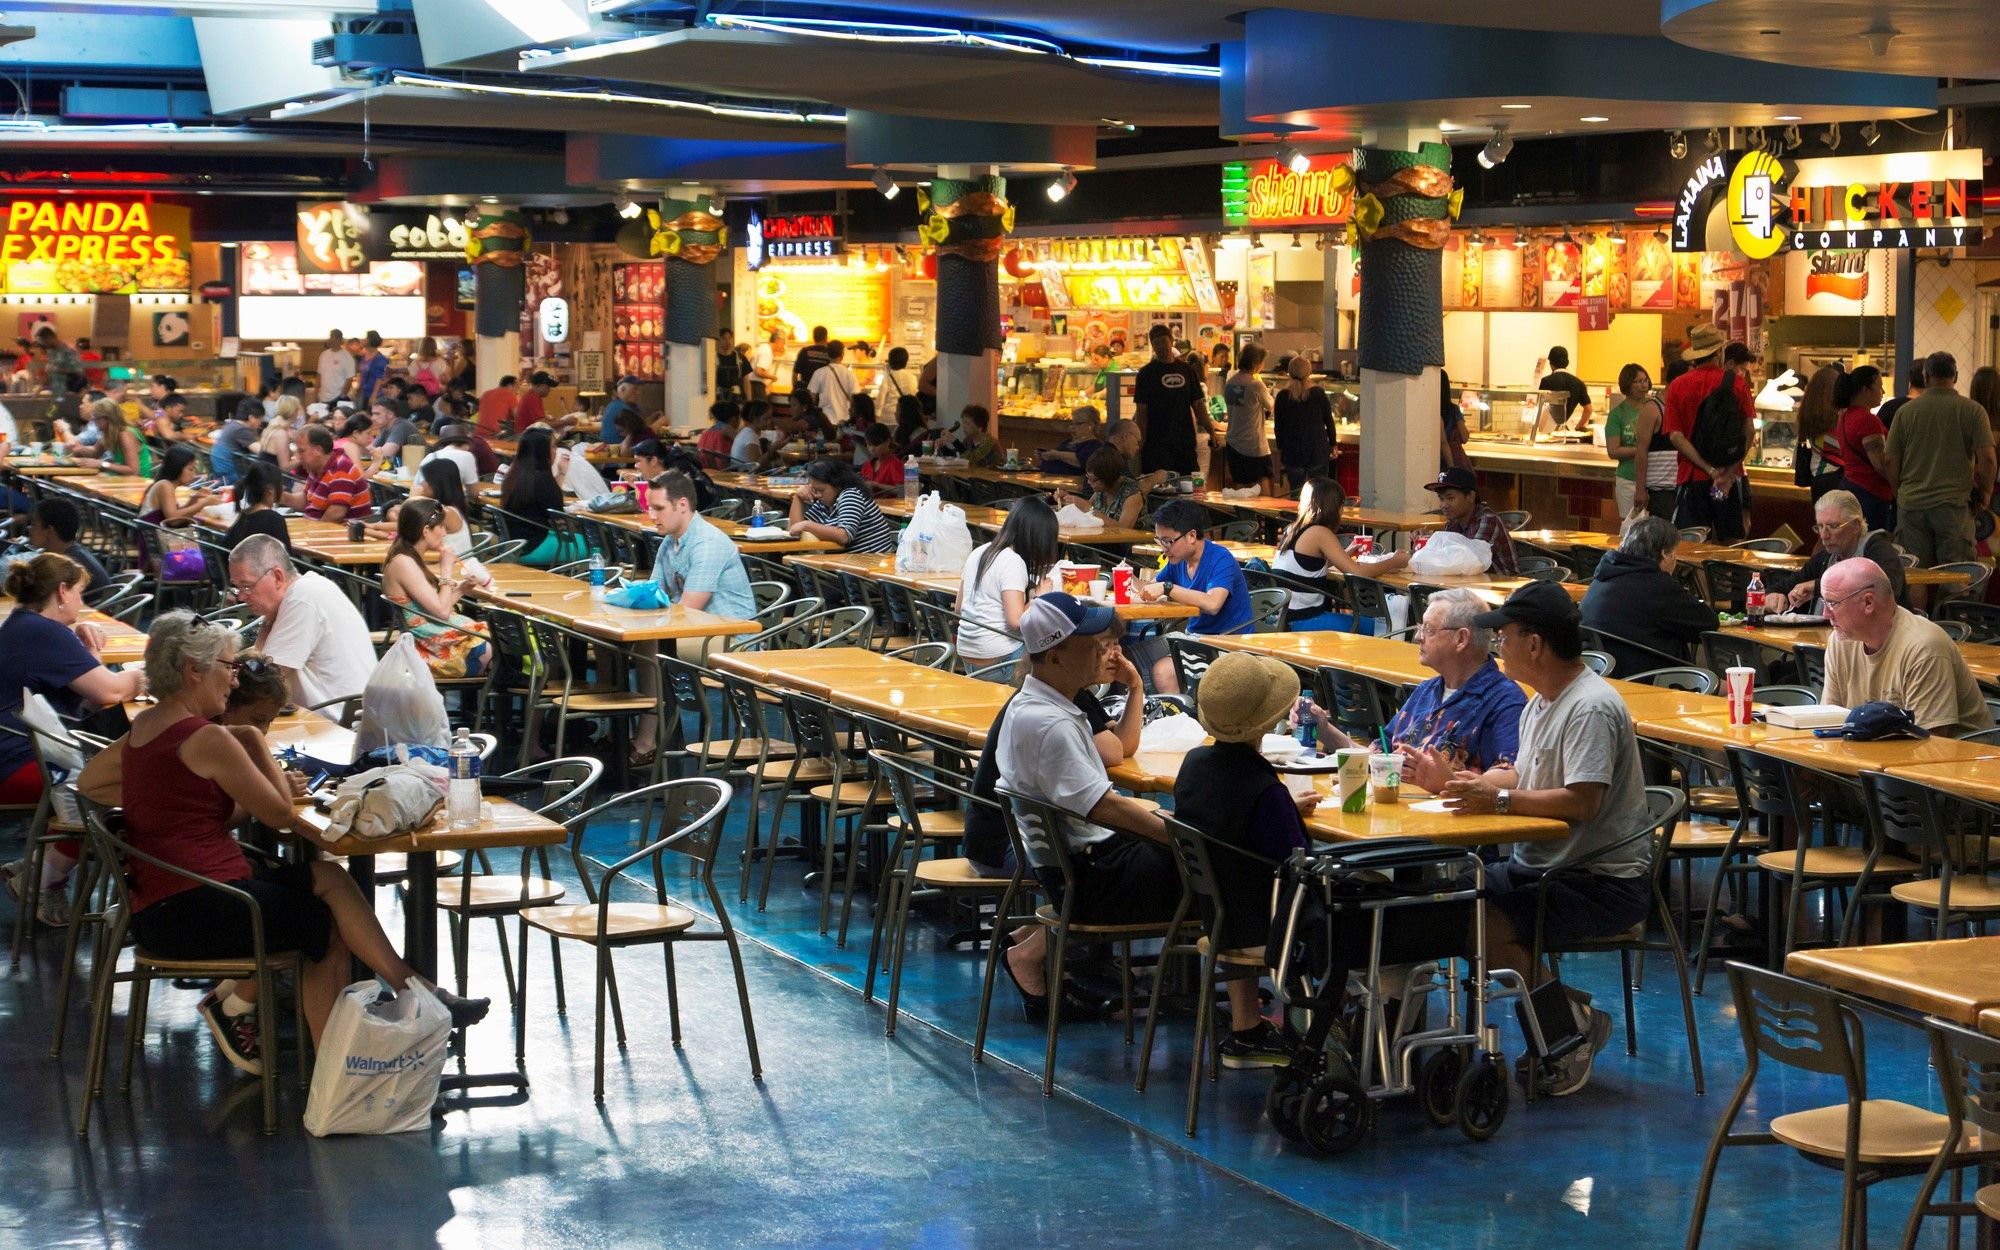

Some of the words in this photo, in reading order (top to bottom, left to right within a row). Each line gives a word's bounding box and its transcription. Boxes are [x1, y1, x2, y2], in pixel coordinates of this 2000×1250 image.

[1676, 156, 1726, 248] LAHAINA
[8, 201, 150, 232] PANDA
[389, 214, 469, 248] soba
[1794, 228, 1964, 249] COMPANY
[1, 234, 176, 265] EXPRESS
[768, 240, 832, 257] EXPRESS
[1810, 250, 1867, 275] sbarro
[346, 1055, 405, 1071] Walmart
